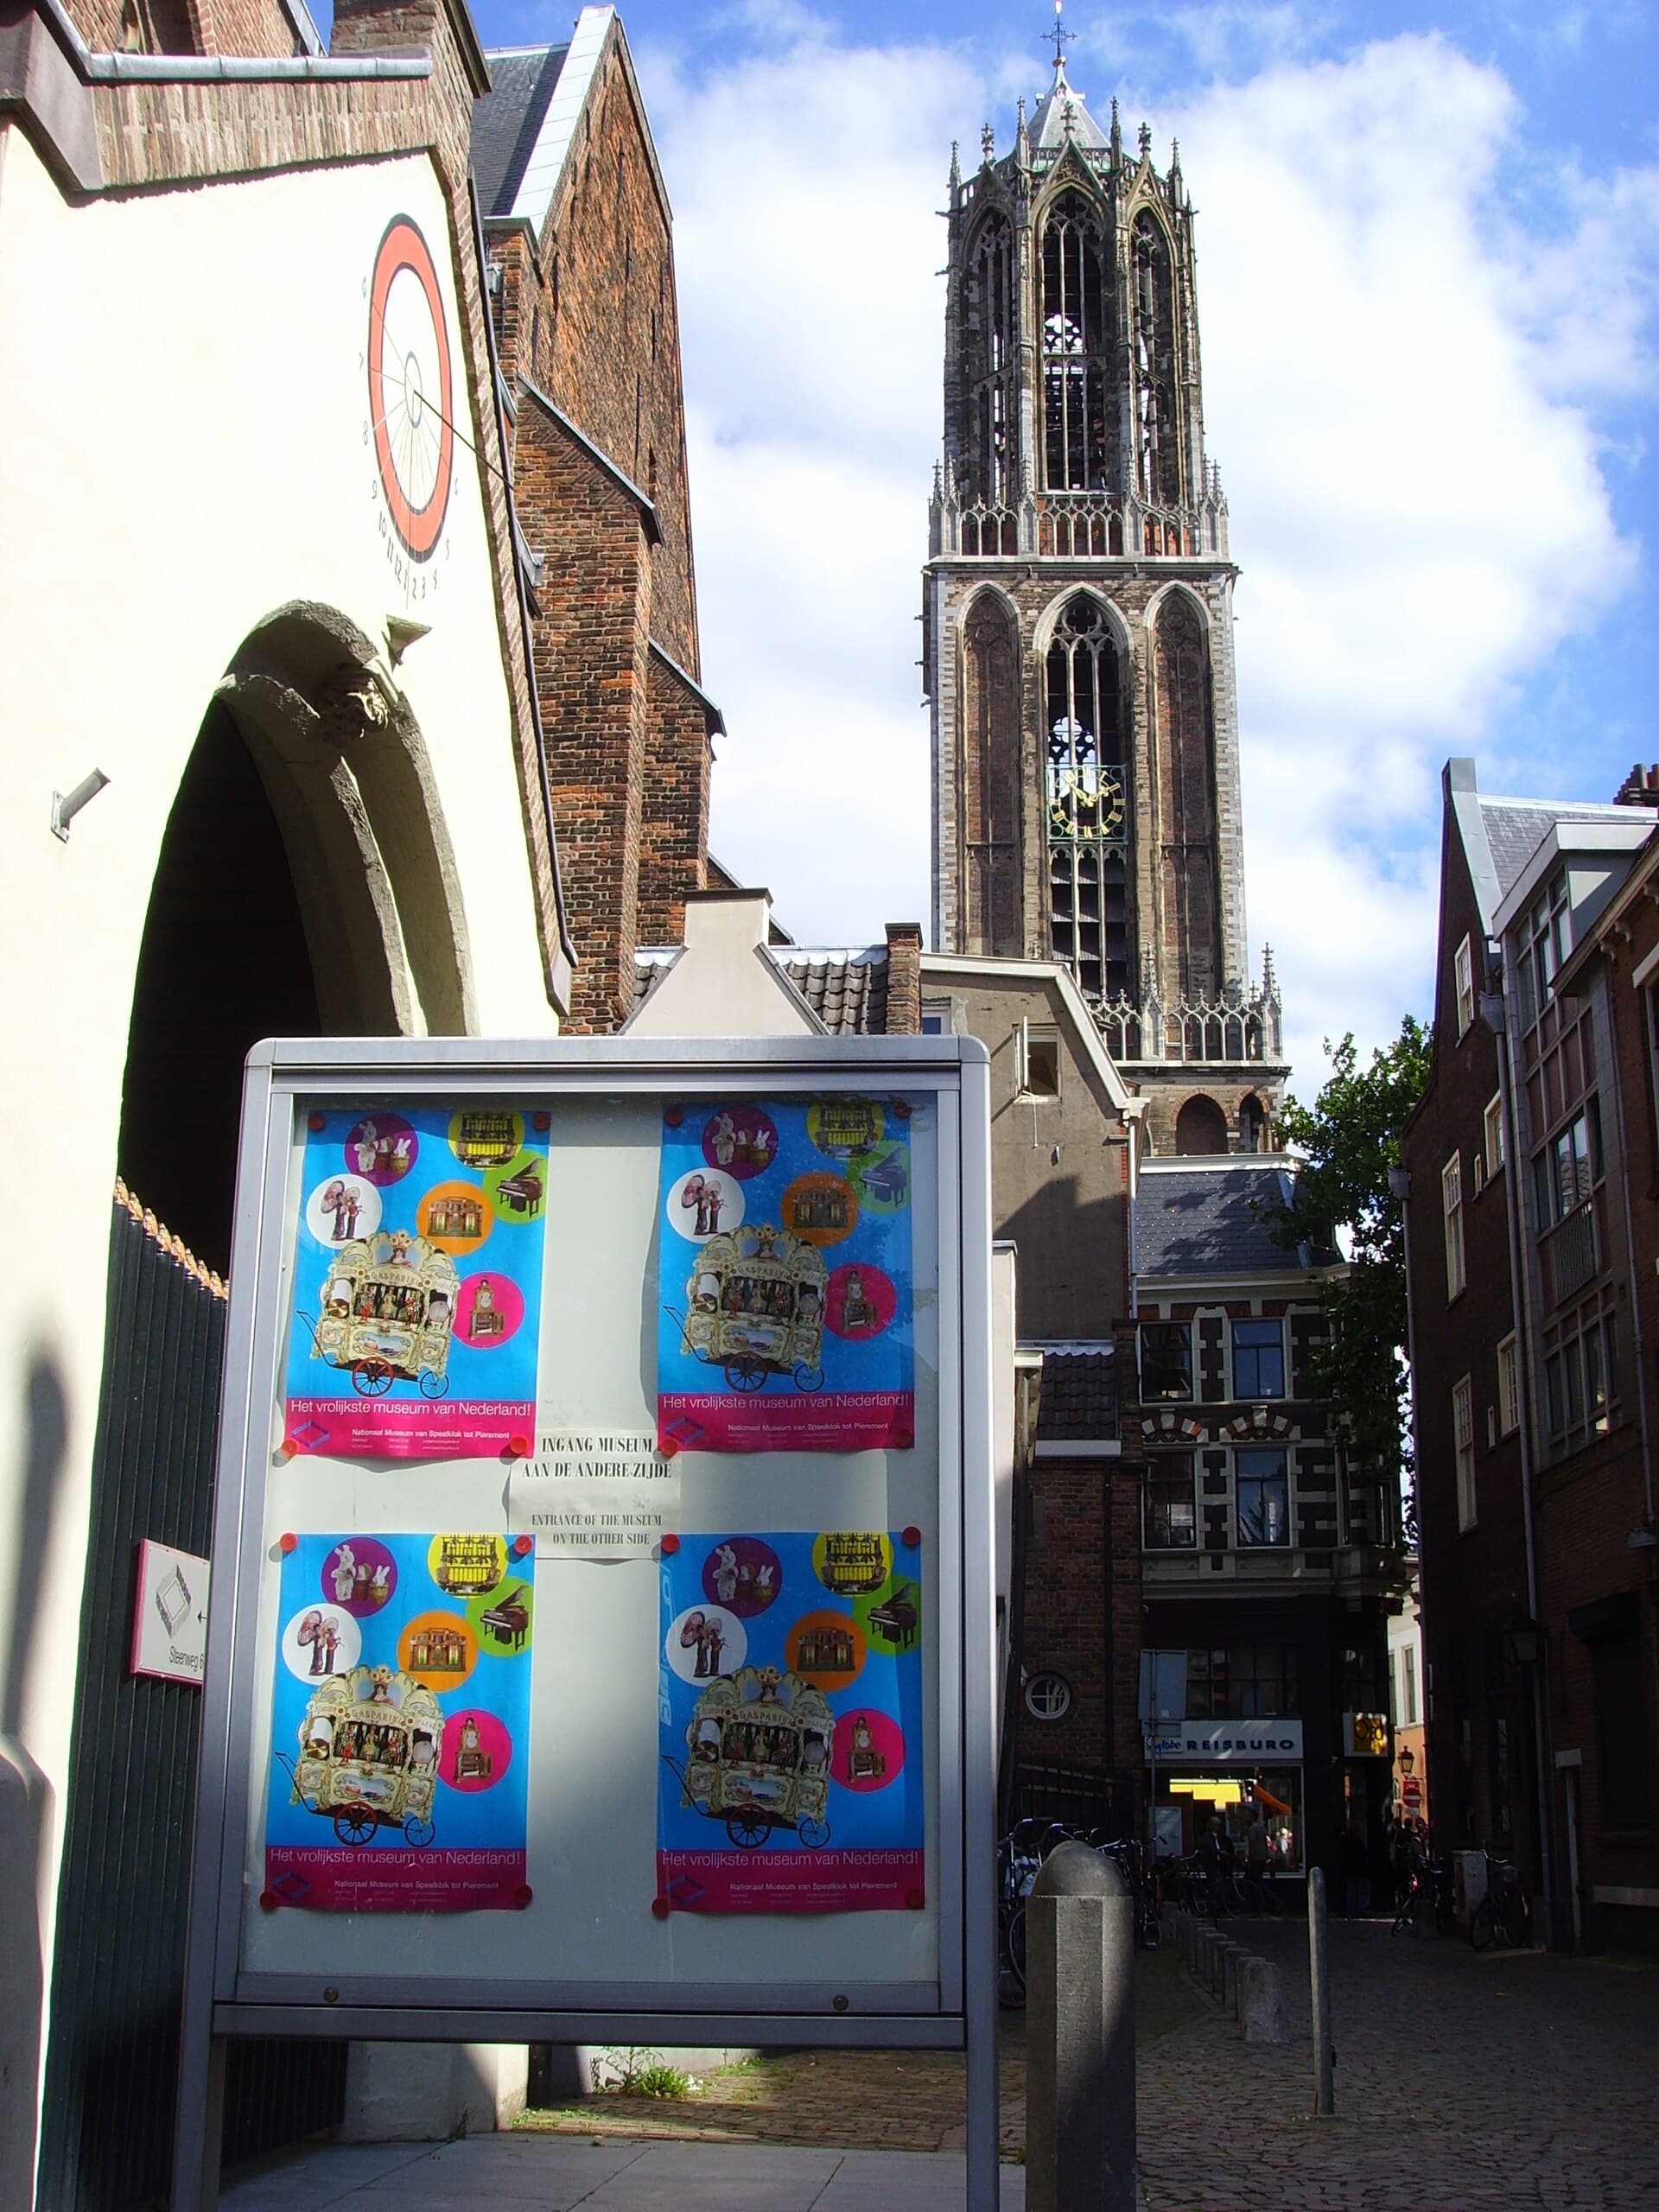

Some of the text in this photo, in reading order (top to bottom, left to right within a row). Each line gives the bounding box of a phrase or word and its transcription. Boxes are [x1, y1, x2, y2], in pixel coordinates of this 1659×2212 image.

[291, 1401, 531, 1416] Het vrolijkste museum van Nederland!
[664, 1394, 908, 1410] Het vrolijkste museum van Nederland!
[542, 1437, 652, 1452] INGANG MUSEUM
[522, 1462, 671, 1479] AAN DE ANDERE ZIJDE
[531, 1514, 662, 1526] ENTRANCE OF THE MUSEUM
[553, 1533, 650, 1545] ON THE OTHER SIDE
[1186, 1739, 1294, 1751] REISBURO
[270, 1849, 520, 1866] Het vrolijkste museum van Nederland!
[663, 1851, 918, 1868] Het vrolijkste museum van Nederland!
